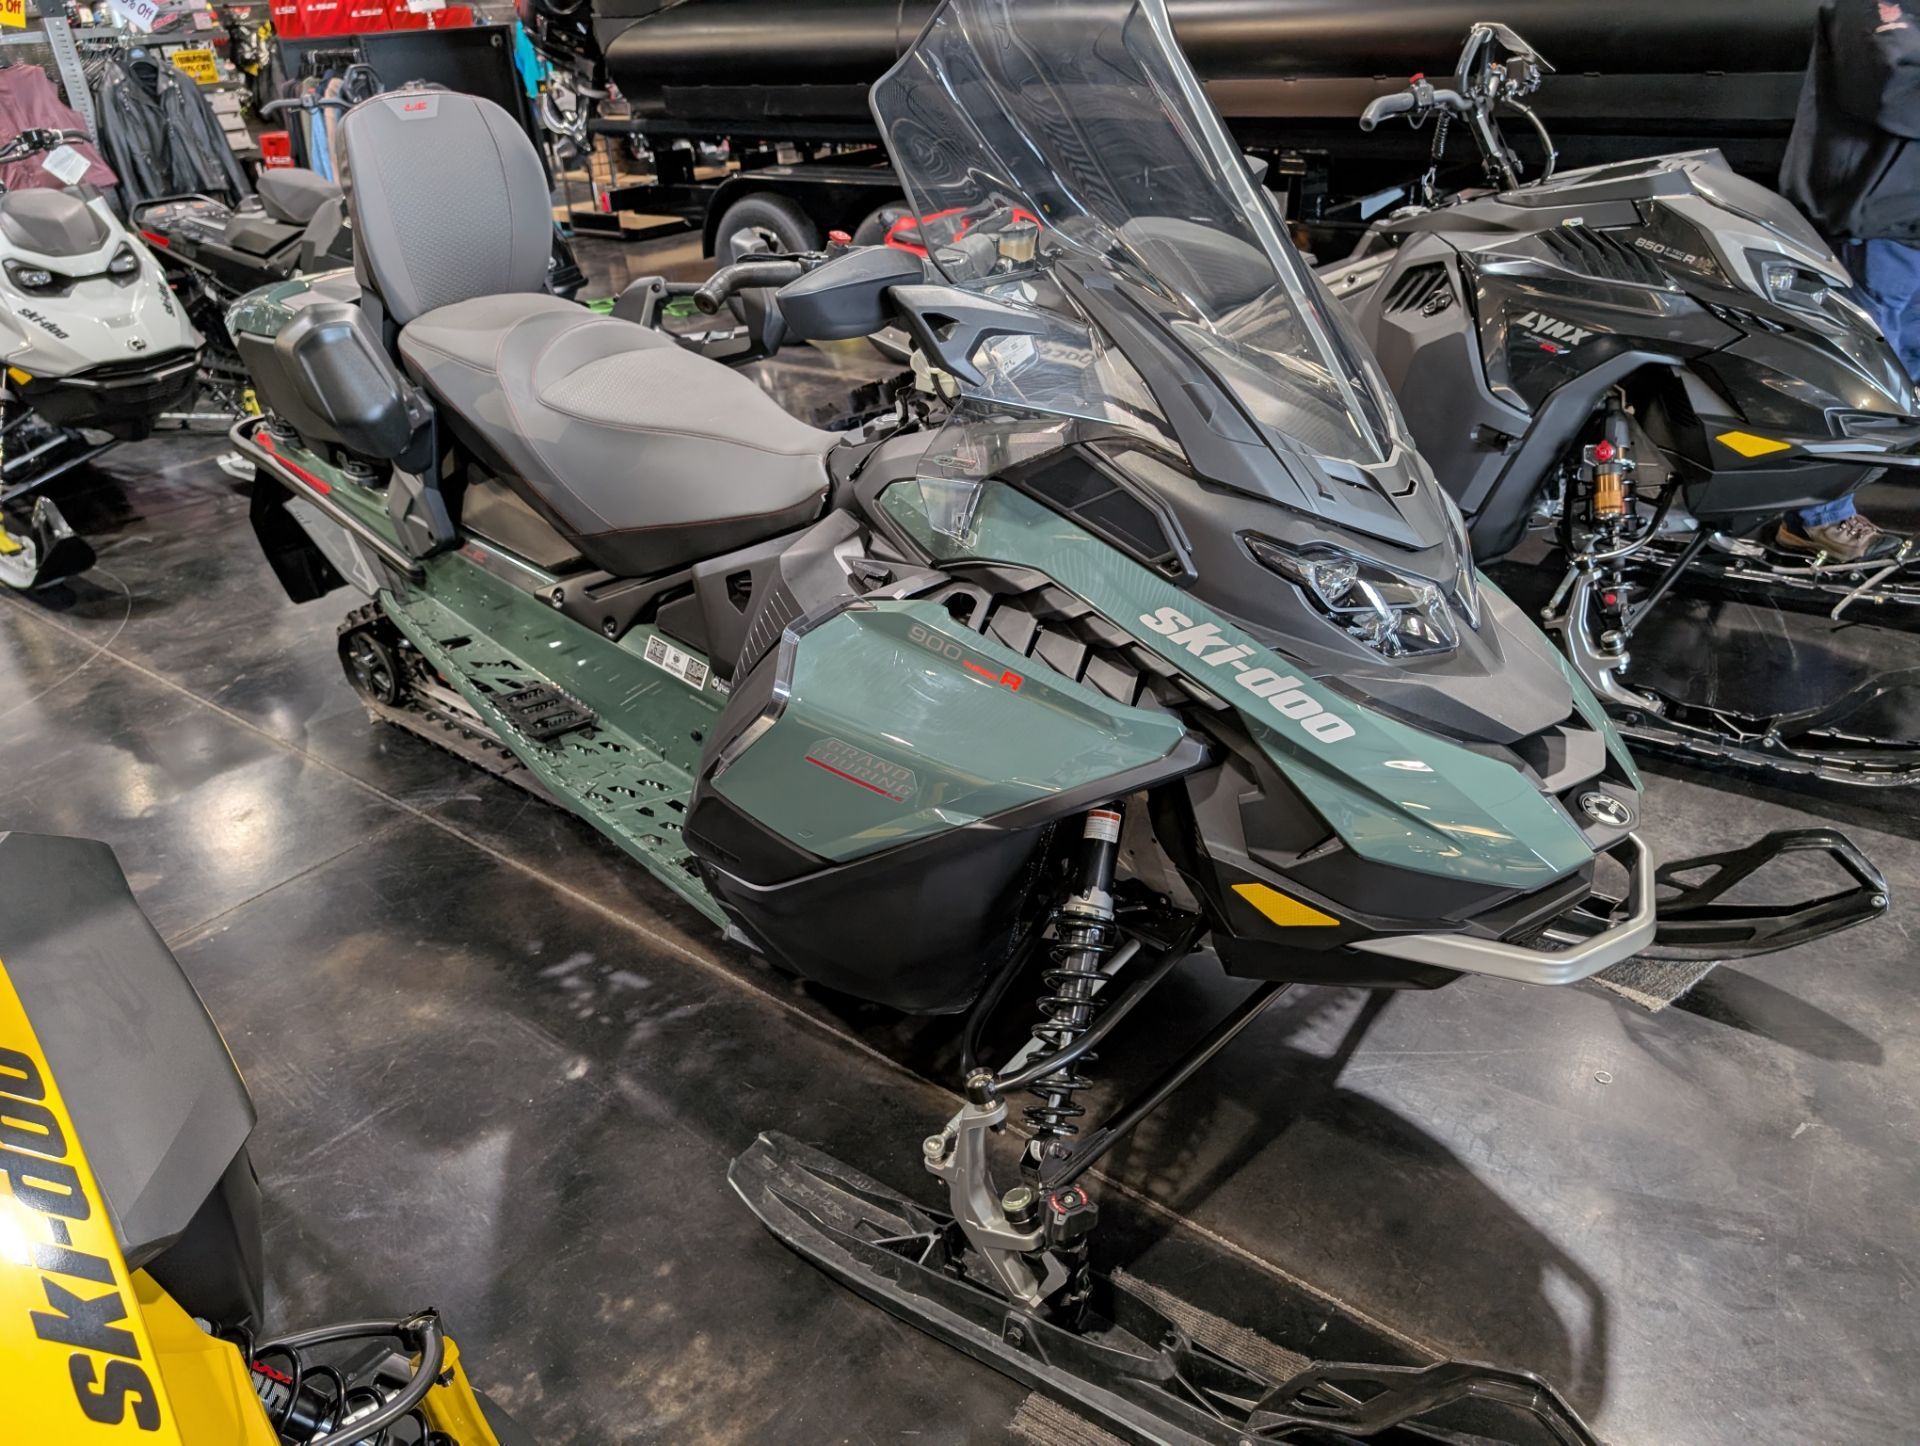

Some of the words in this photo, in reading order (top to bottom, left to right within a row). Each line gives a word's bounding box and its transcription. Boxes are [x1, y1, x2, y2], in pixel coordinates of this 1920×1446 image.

[7, 0, 21, 14] Off
[136, 4, 154, 18] Off
[1634, 237, 1665, 254] 850
[1682, 254, 1696, 264] R
[18, 308, 69, 339] ski-doo
[1516, 311, 1594, 346] LYNX
[908, 624, 962, 660] 900
[1000, 670, 1023, 692] R
[1139, 607, 1356, 744] ski-doo
[826, 741, 911, 780] GRAND
